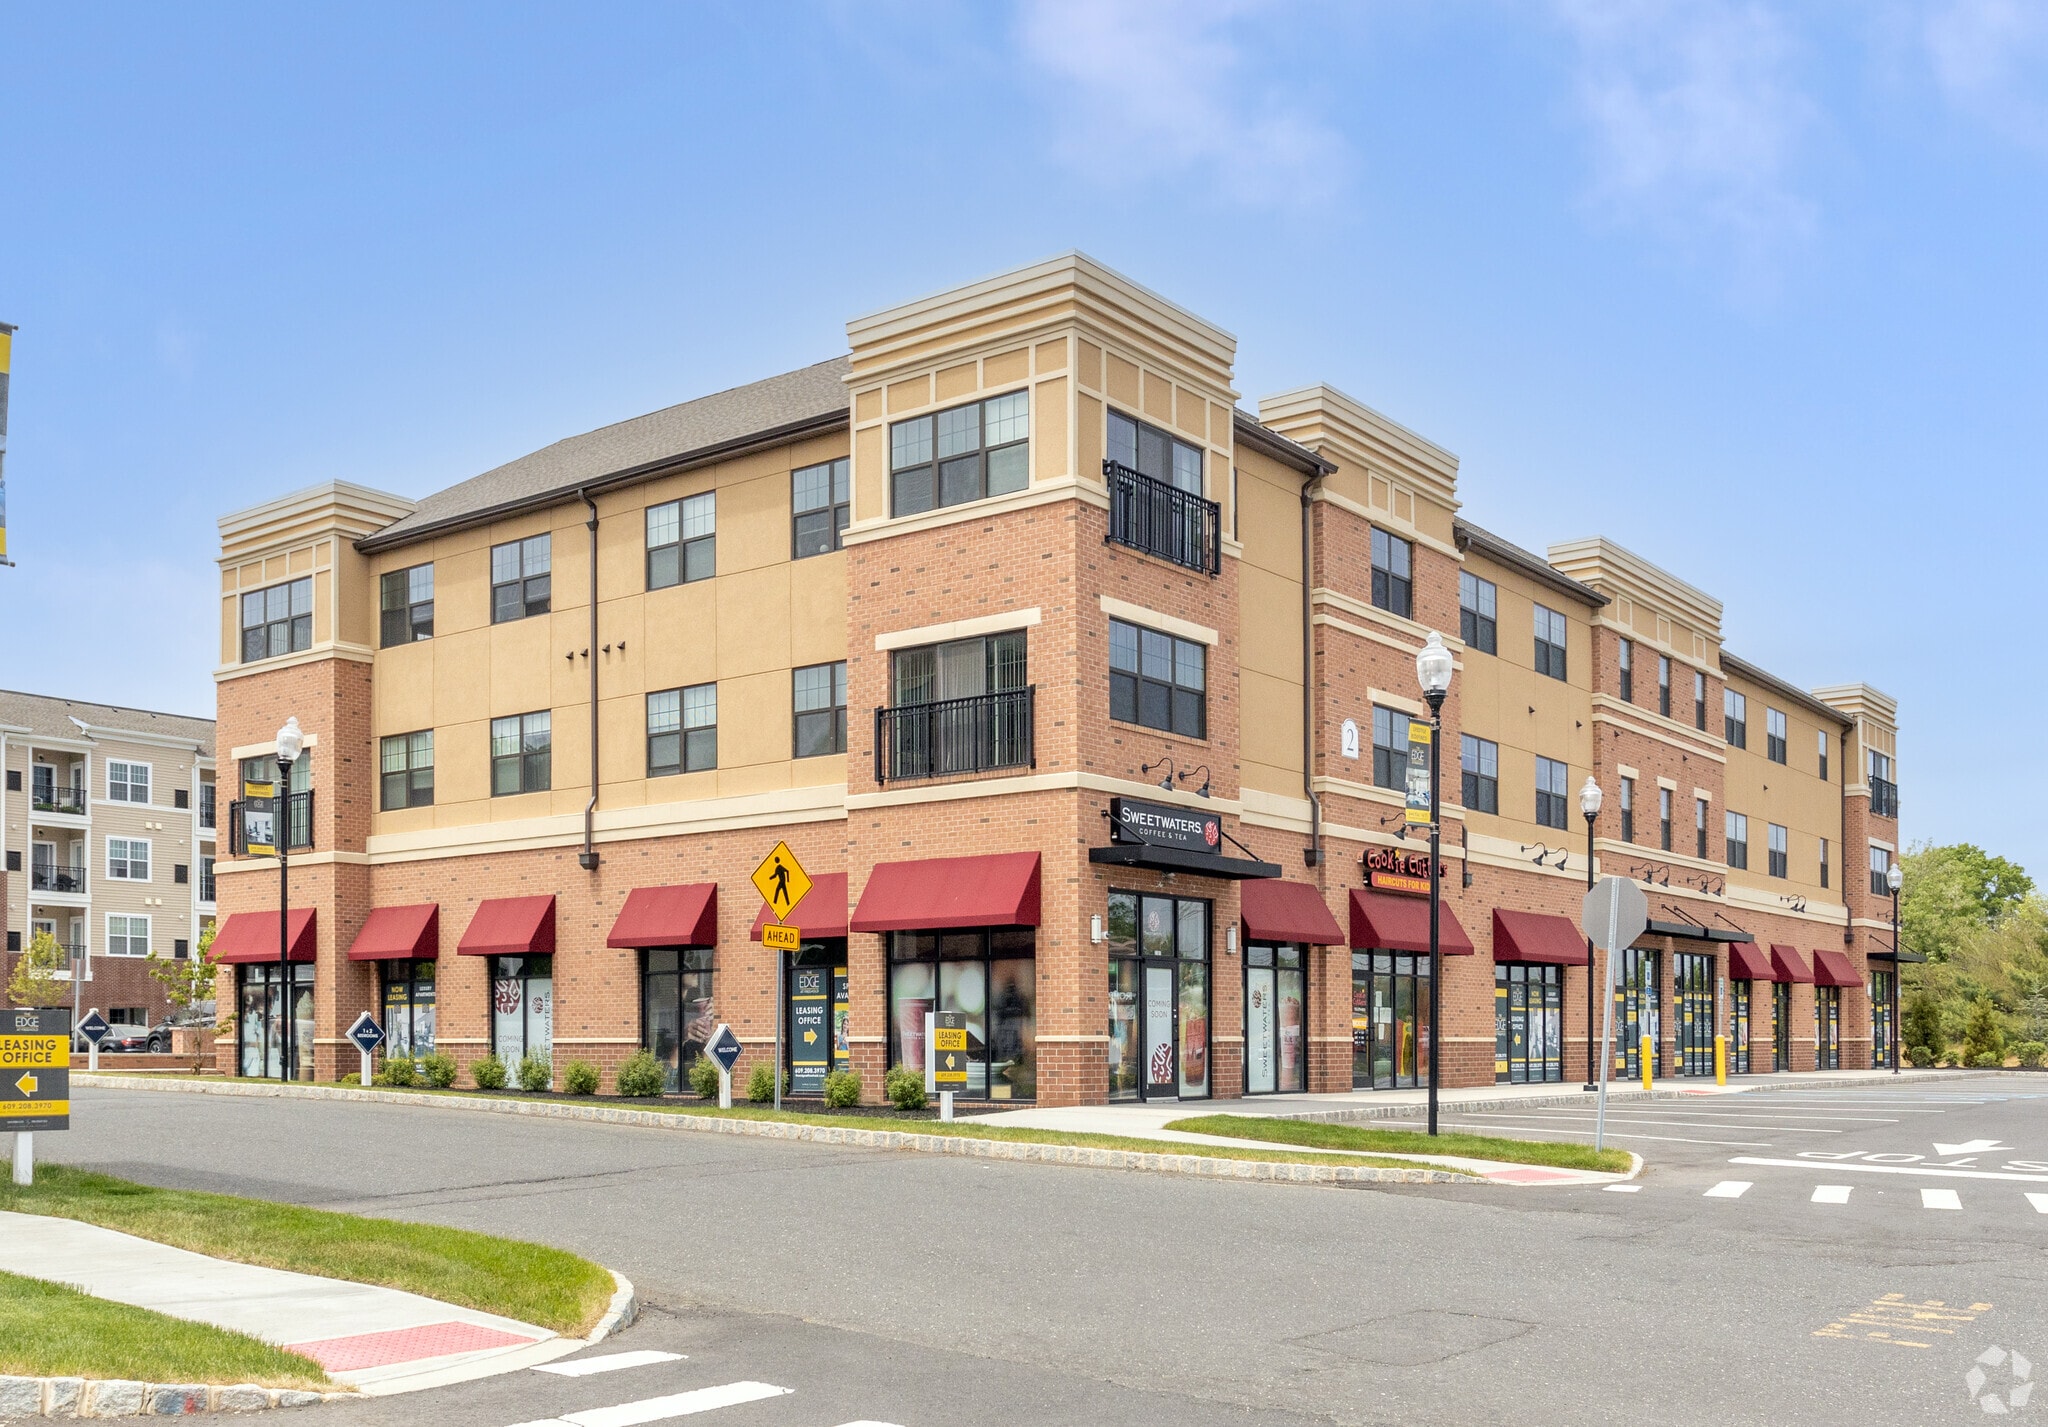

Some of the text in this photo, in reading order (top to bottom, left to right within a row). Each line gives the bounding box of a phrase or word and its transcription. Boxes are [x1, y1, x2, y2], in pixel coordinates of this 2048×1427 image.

[1347, 728, 1354, 751] 2
[1122, 807, 1202, 834] SWEETWATERS
[1139, 828, 1165, 838] COFFEE
[1377, 875, 1408, 889] HAIRCUTS
[1408, 880, 1420, 891] FOR
[767, 930, 795, 944] AHEAD
[799, 976, 820, 988] EDGE
[1147, 1000, 1170, 1008] COMING
[795, 1006, 824, 1015] LEASING
[15, 1016, 39, 1027] EDGE
[798, 1017, 822, 1025] OFFICE
[497, 1034, 523, 1043] COMING
[938, 1031, 962, 1040] LEASING
[940, 1040, 961, 1048] OFFICE
[501, 1045, 521, 1054] SOON
[2, 1051, 53, 1063] OFFICE
[1796, 1150, 2048, 1173] STOP
